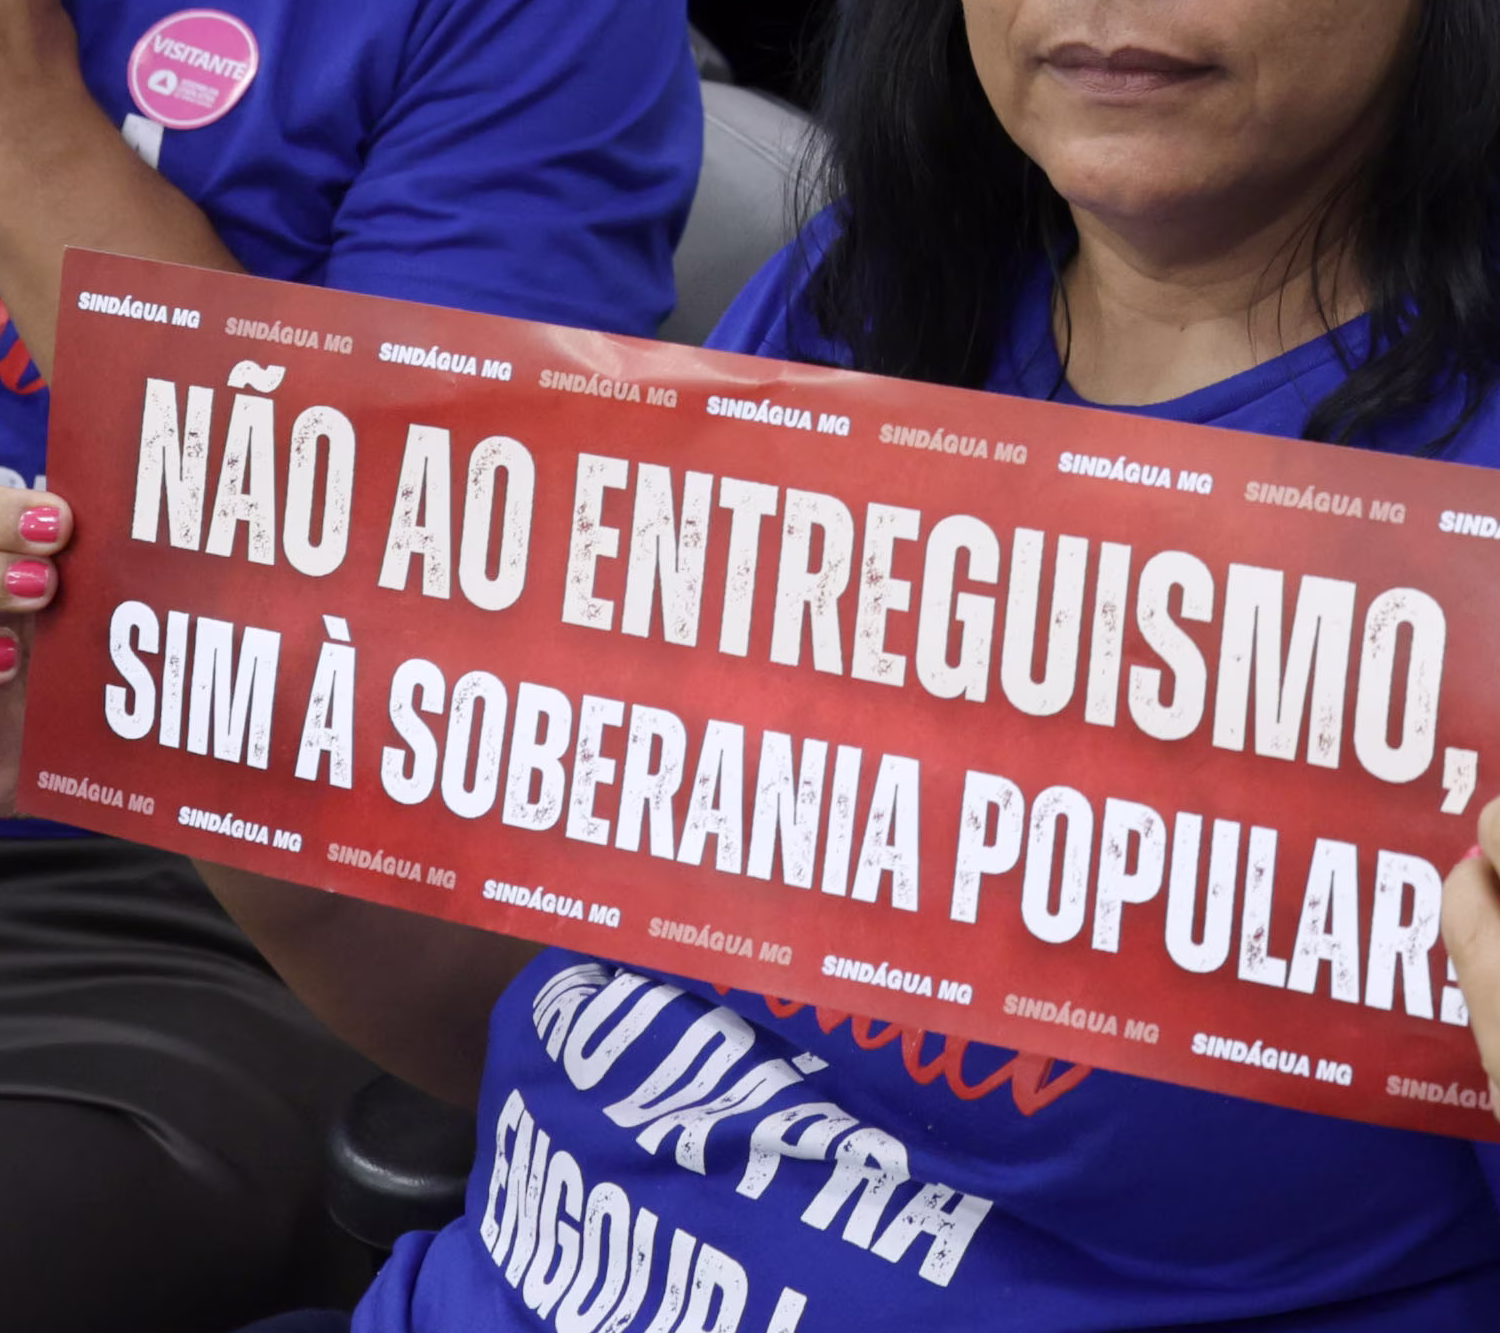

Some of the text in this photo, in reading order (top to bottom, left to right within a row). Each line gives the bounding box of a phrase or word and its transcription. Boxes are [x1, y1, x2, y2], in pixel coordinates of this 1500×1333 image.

[153, 34, 248, 81] VISITANTE
[79, 292, 200, 329] SINDÁGUA MG
[379, 343, 512, 380] SINDÁGUA MG
[707, 396, 850, 435] SINDÁGUA MG
[1059, 452, 1212, 494] SINDÁGUA MG
[132, 359, 1478, 814] NÃO AO ENTREGUISMO,
[105, 600, 281, 771] SIM
[296, 615, 356, 789] À
[381, 658, 920, 912] SOBERANIA
[483, 879, 621, 927] SINDÁGUA MG
[822, 956, 973, 1005] SINDÁGUA MG
[1192, 1033, 1353, 1085] SINDÁGUA MG
[603, 1005, 829, 1174] DÁ
[736, 1103, 994, 1287] PRA
